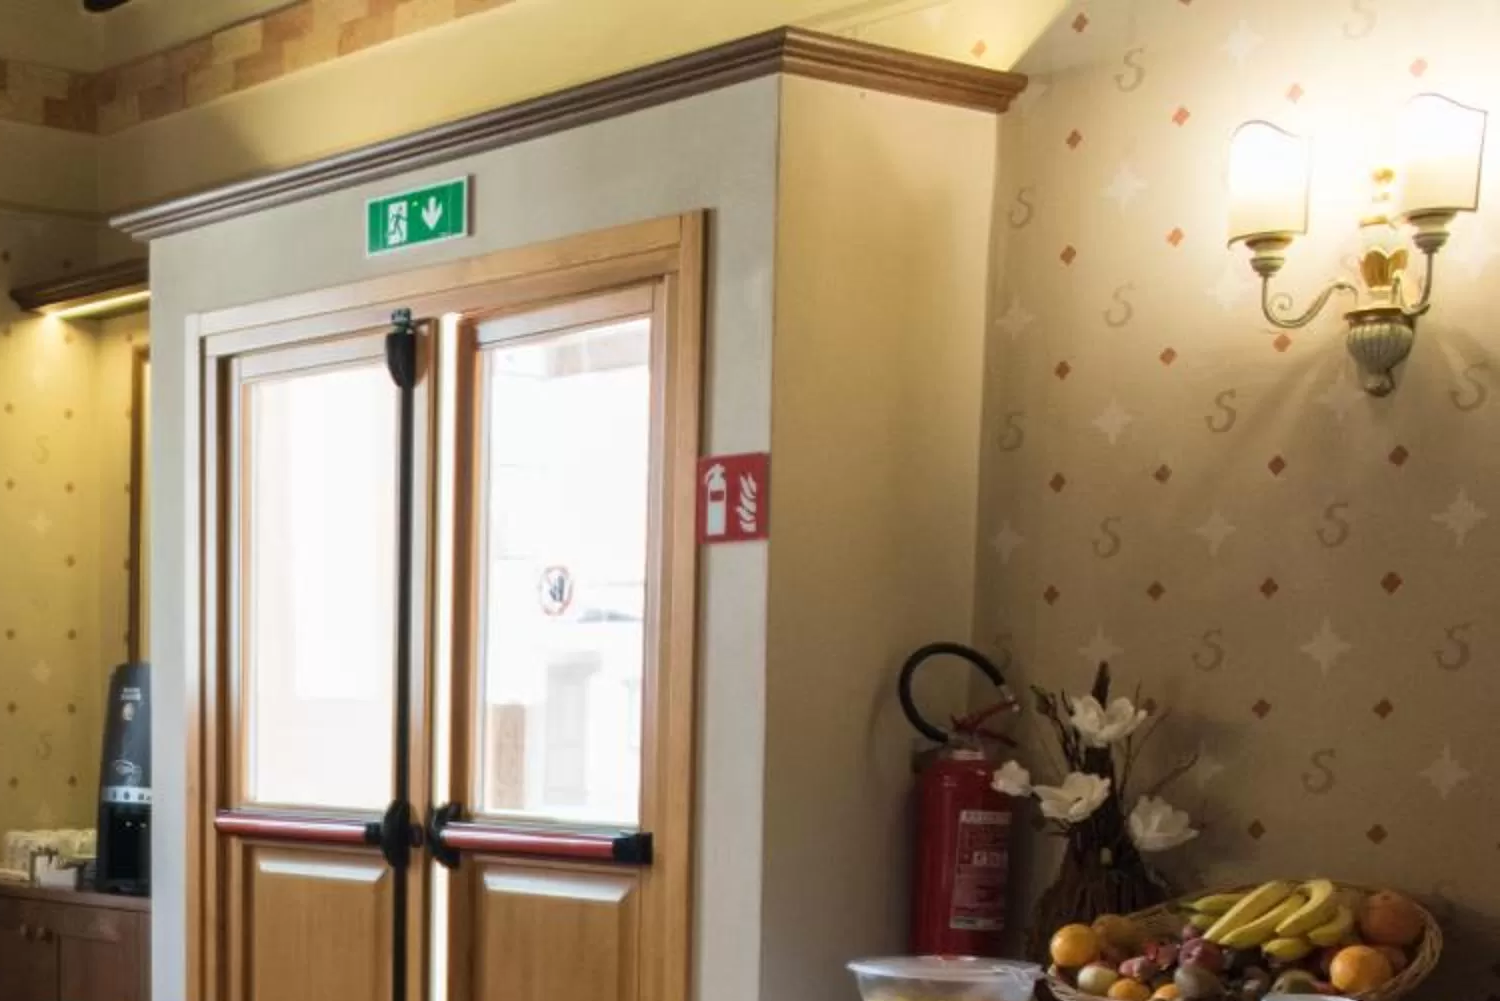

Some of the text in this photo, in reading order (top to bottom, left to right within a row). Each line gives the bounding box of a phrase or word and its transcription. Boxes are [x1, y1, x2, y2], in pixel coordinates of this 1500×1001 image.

[1114, 47, 1147, 92] S
[1008, 188, 1034, 229] S
[1104, 283, 1135, 327] S
[1450, 362, 1488, 412] S
[997, 411, 1025, 452] S
[1205, 388, 1237, 432] S
[1092, 517, 1121, 558] S
[1316, 503, 1350, 548] S
[1192, 628, 1224, 672] S
[1434, 622, 1474, 671] S
[1302, 749, 1337, 794] S
